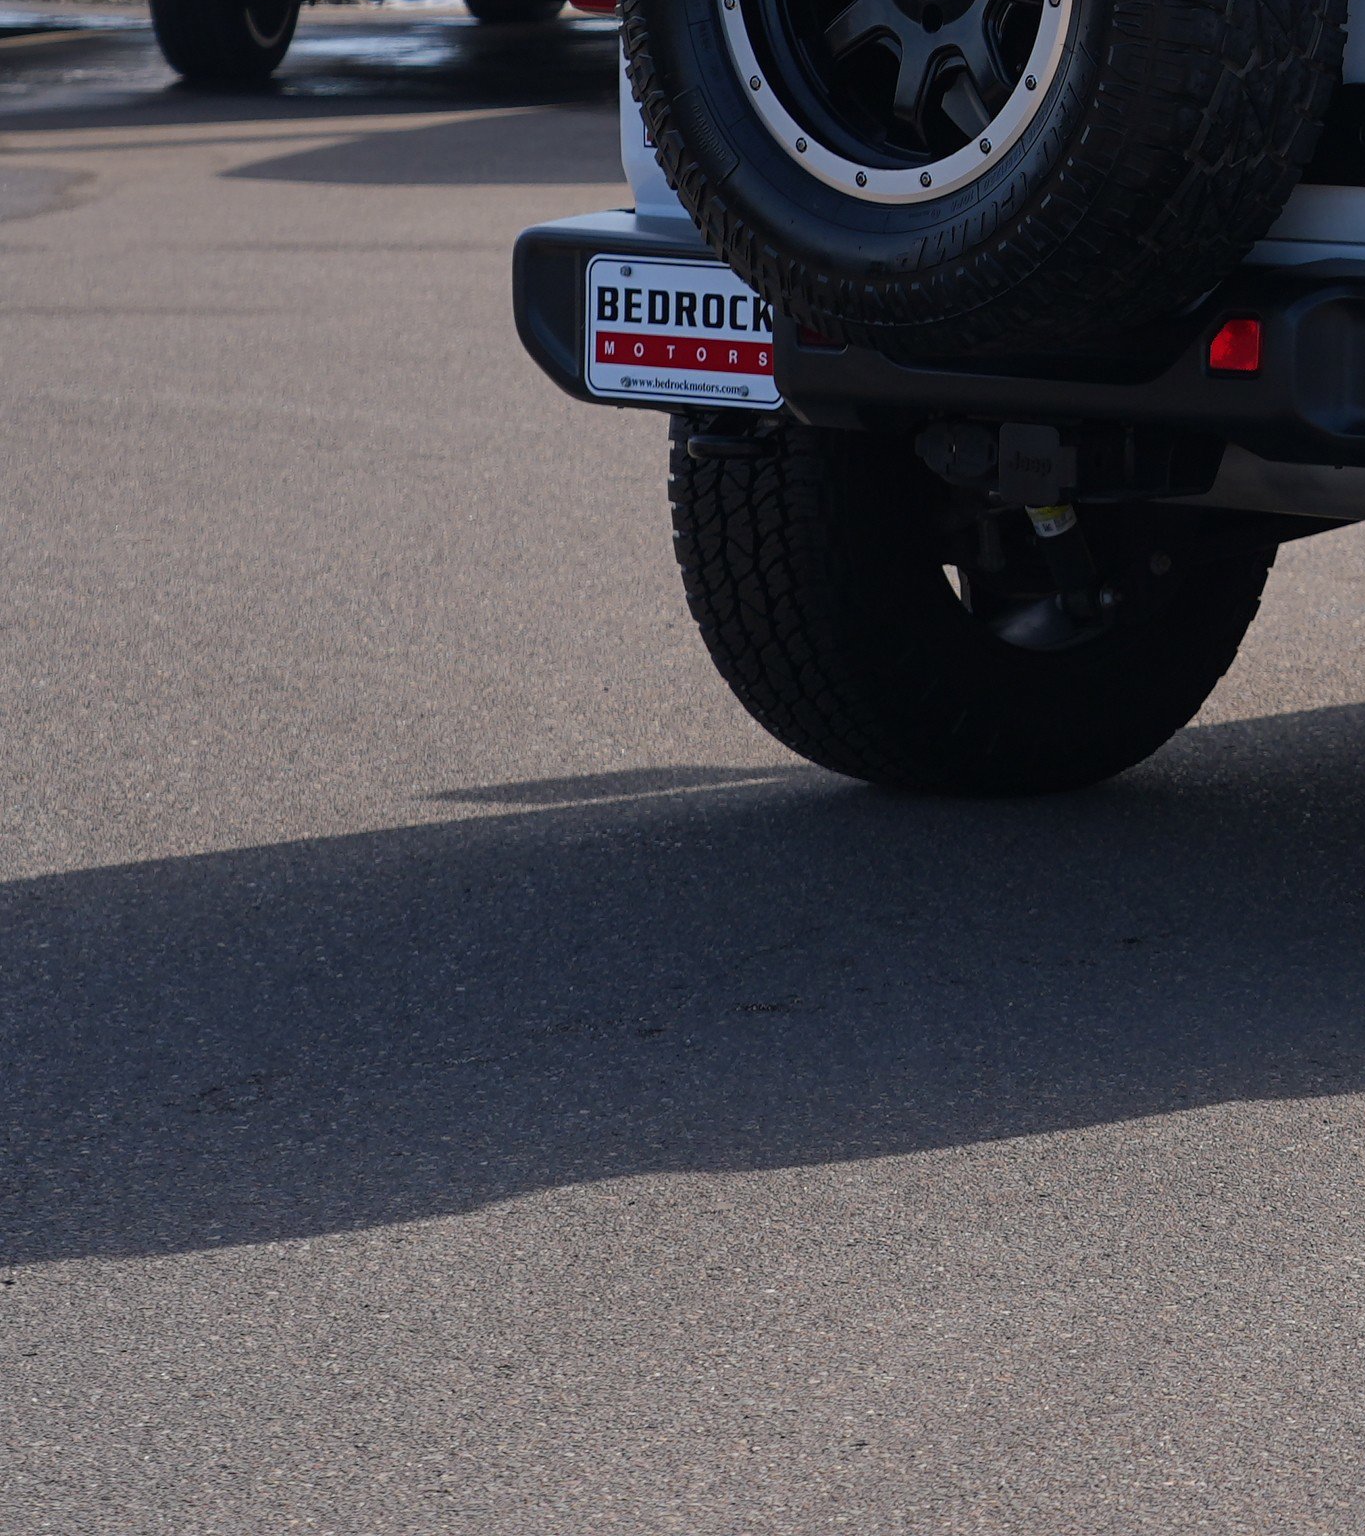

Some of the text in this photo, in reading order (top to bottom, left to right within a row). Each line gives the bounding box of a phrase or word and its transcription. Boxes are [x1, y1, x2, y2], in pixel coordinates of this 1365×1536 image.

[596, 286, 773, 333] BEDROCK
[604, 340, 768, 367] MOTORS
[631, 376, 741, 395] www.bedrockmotors.com
